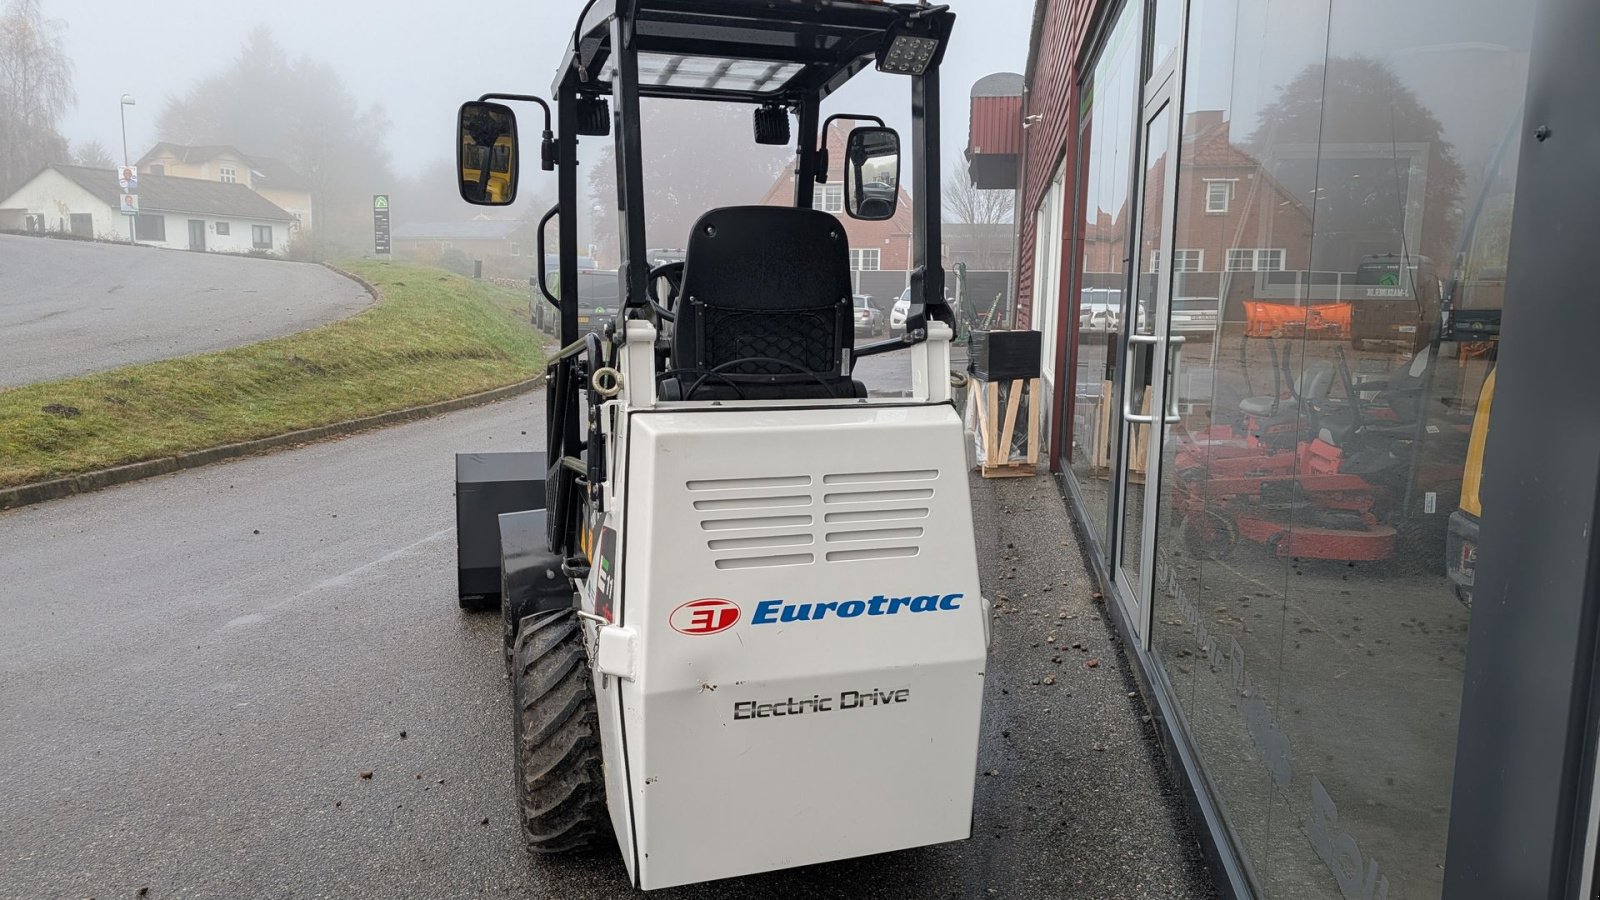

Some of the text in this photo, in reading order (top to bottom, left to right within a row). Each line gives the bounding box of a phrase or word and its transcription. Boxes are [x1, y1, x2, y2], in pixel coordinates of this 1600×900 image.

[751, 594, 964, 625] Eurotrac
[733, 688, 910, 720] Electric Drive
